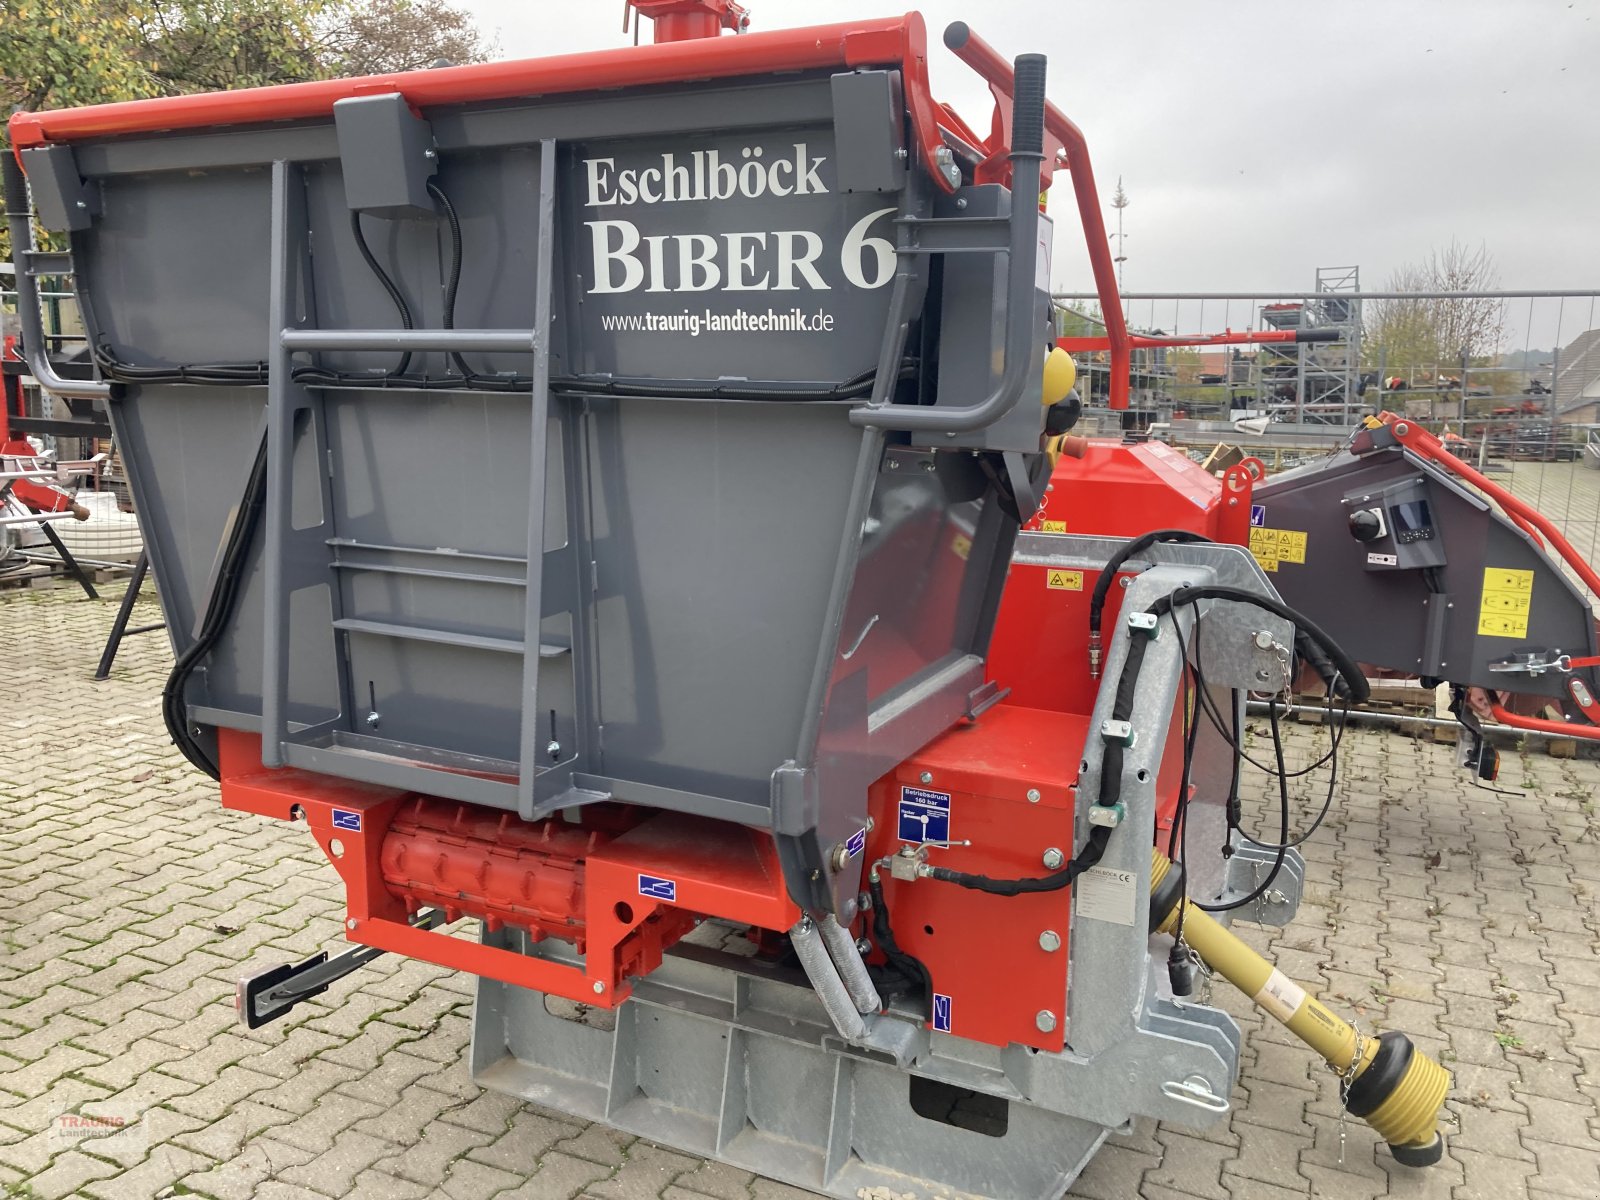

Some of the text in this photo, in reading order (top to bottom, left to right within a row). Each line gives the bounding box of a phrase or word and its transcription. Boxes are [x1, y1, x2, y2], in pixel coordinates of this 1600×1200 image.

[582, 143, 830, 207] Eschlböck
[583, 207, 899, 294] BIBER 6
[602, 308, 834, 336] www.traurig-landtechnik.de
[905, 788, 948, 801] Betriebsdruck
